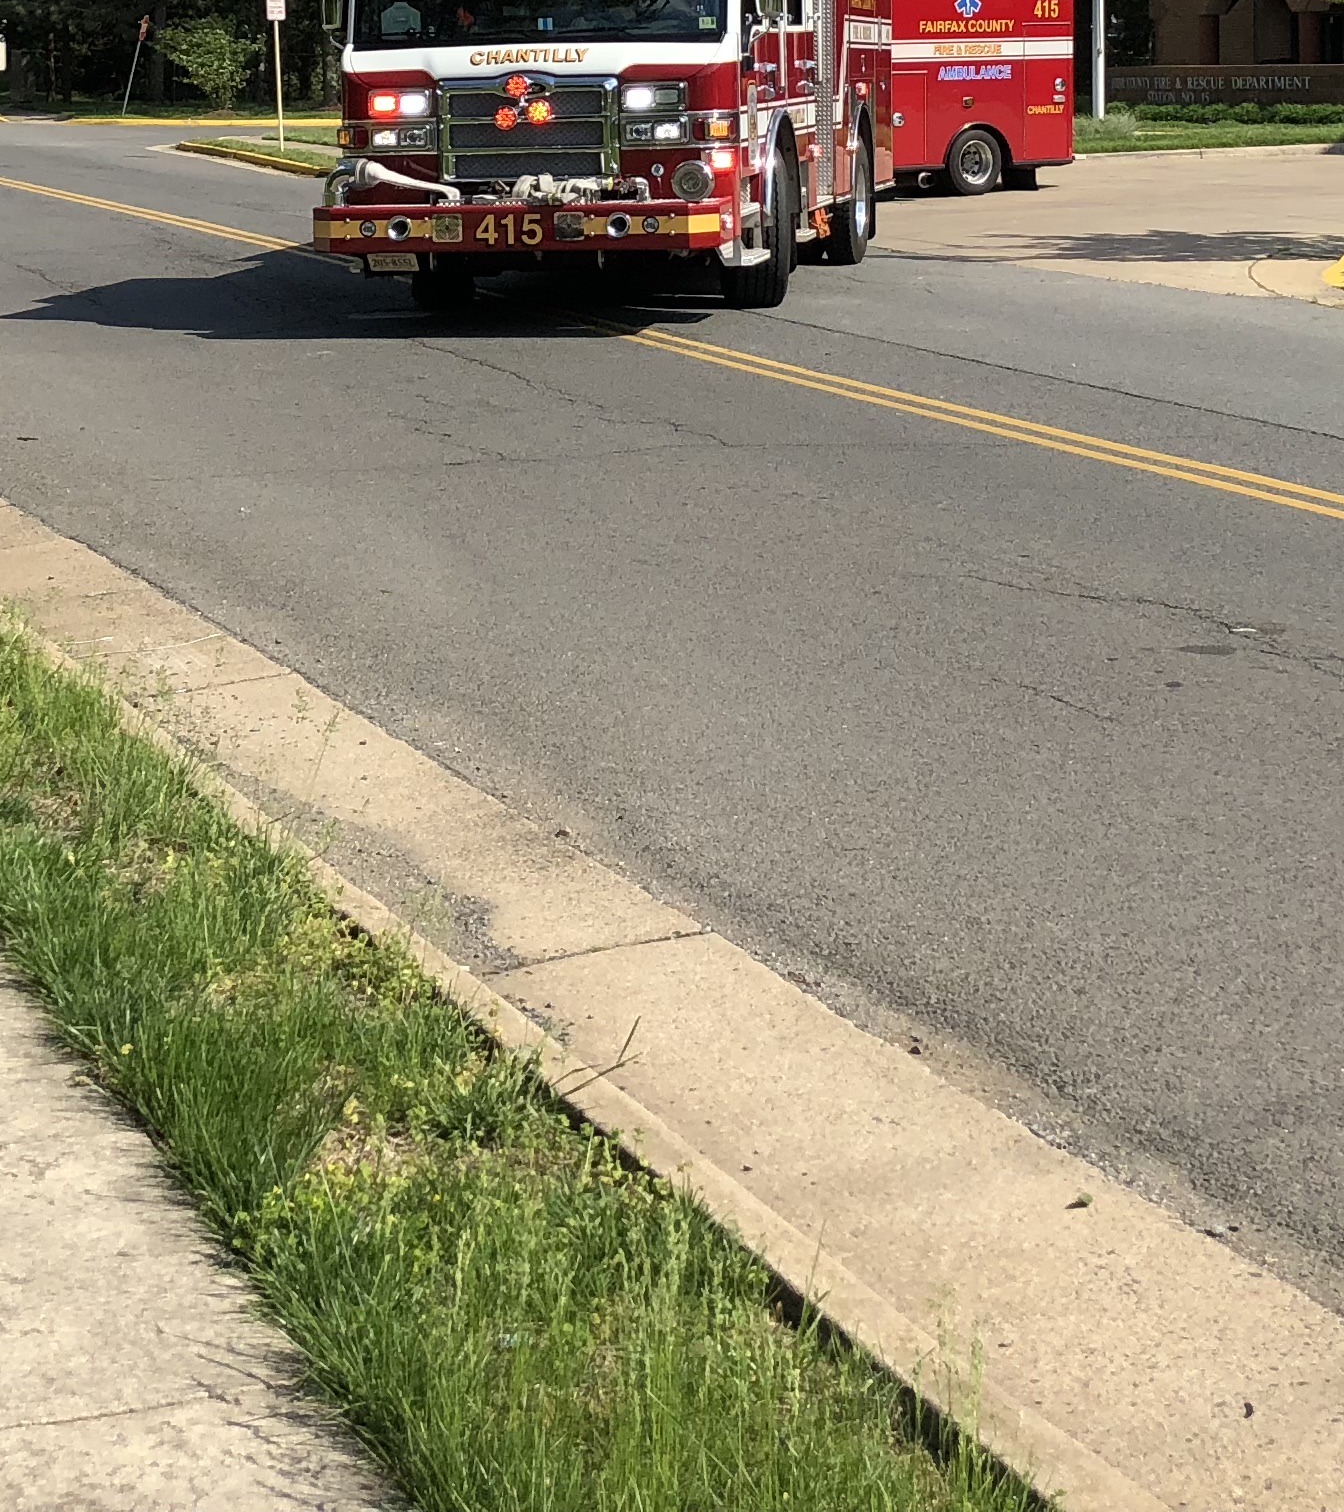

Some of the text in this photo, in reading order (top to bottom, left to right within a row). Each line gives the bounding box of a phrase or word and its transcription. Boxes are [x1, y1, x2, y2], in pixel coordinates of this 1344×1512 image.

[1033, 0, 1059, 18] 415
[919, 19, 1015, 33] FAIRFAX COUNTY
[470, 47, 589, 66] CHANTILLY
[933, 45, 954, 55] FIRE
[964, 44, 1002, 55] RESCUE
[937, 65, 1012, 81] AMBULANCE
[1187, 76, 1225, 89] RESCUE
[1231, 76, 1311, 89] DEPARTMENT
[1027, 104, 1064, 115] CHANTILLY
[475, 213, 544, 245] 415
